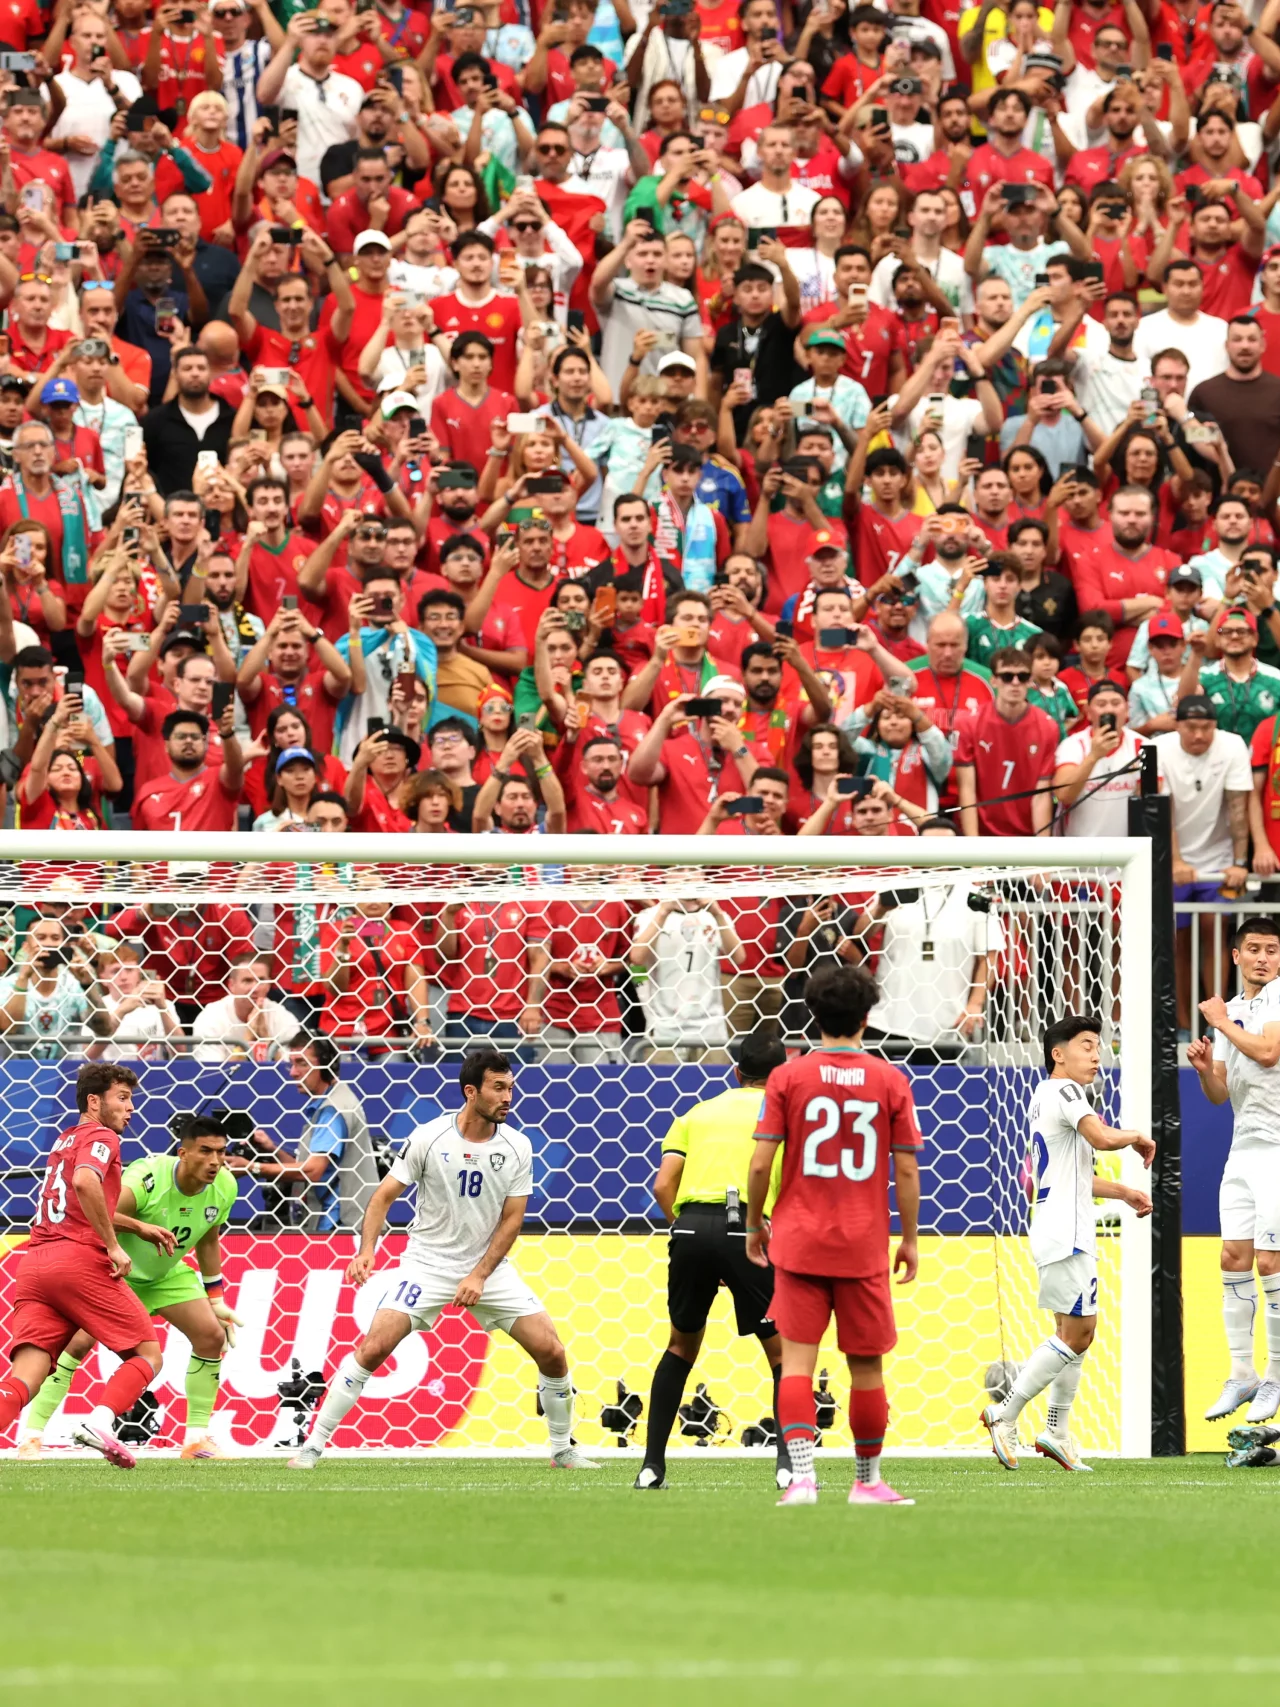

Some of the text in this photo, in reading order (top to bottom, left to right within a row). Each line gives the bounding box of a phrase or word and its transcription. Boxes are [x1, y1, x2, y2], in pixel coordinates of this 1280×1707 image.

[861, 350, 872, 378] 7
[1002, 760, 1015, 789] 7
[685, 951, 694, 973] 7
[819, 1064, 865, 1087] VITINHA
[803, 1096, 879, 1182] 23
[458, 1169, 483, 1198] 18
[394, 1280, 422, 1308] 18
